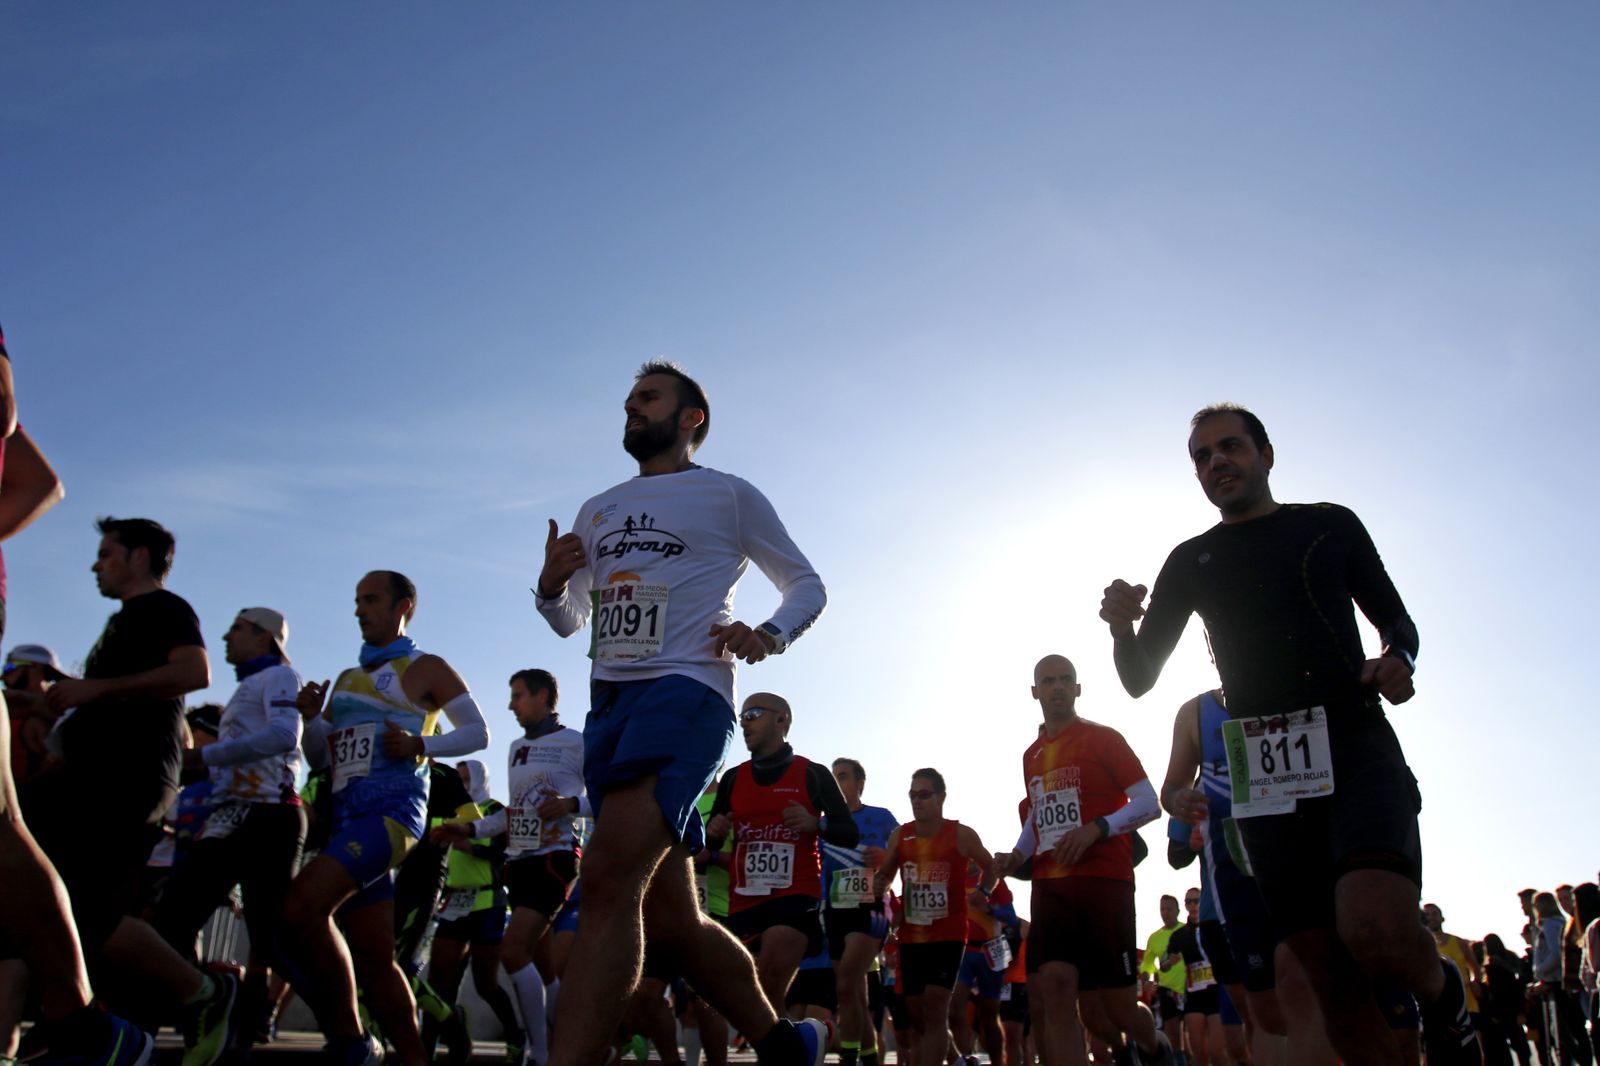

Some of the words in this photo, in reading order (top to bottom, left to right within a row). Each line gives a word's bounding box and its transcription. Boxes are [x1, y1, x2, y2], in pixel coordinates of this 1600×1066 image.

[599, 604, 658, 639] 2091
[1260, 733, 1312, 774] 811
[1273, 773, 1302, 784] ROMERO
[1303, 770, 1330, 781] ROJAS
[747, 853, 790, 873] 3501
[845, 877, 869, 892] 786
[912, 892, 946, 908] 1133
